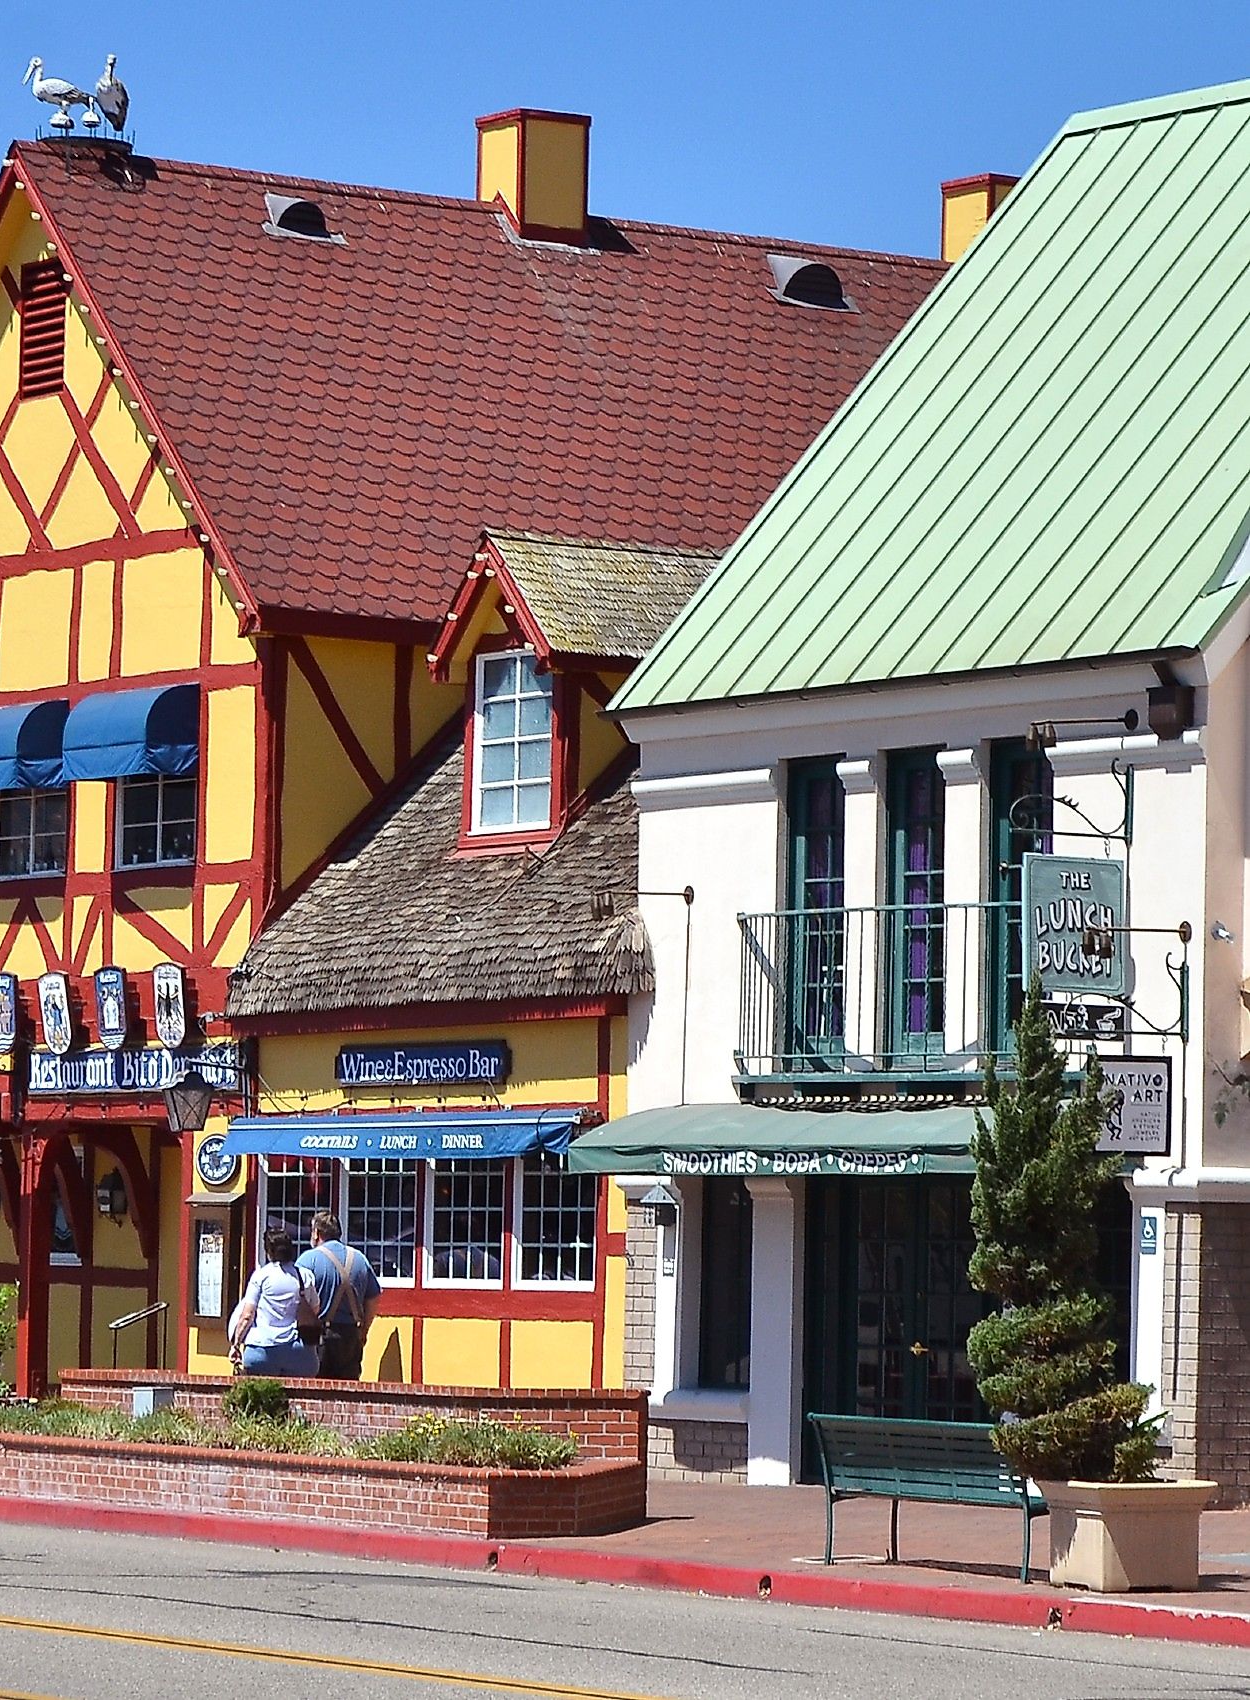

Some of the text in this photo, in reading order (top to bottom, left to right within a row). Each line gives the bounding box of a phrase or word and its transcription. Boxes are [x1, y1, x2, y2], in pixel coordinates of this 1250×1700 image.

[1060, 871, 1091, 890] THE
[1035, 898, 1114, 938] LUNCH
[29, 1051, 114, 1090] Restaurant
[469, 1049, 498, 1079] Bar
[1105, 1073, 1163, 1087] NATIVO
[1133, 1089, 1163, 1103] ART
[300, 1135, 484, 1149] COCKTAILS LUNCH DINNER
[663, 1152, 906, 1174] SMOOTHIES BOBA CREPES
